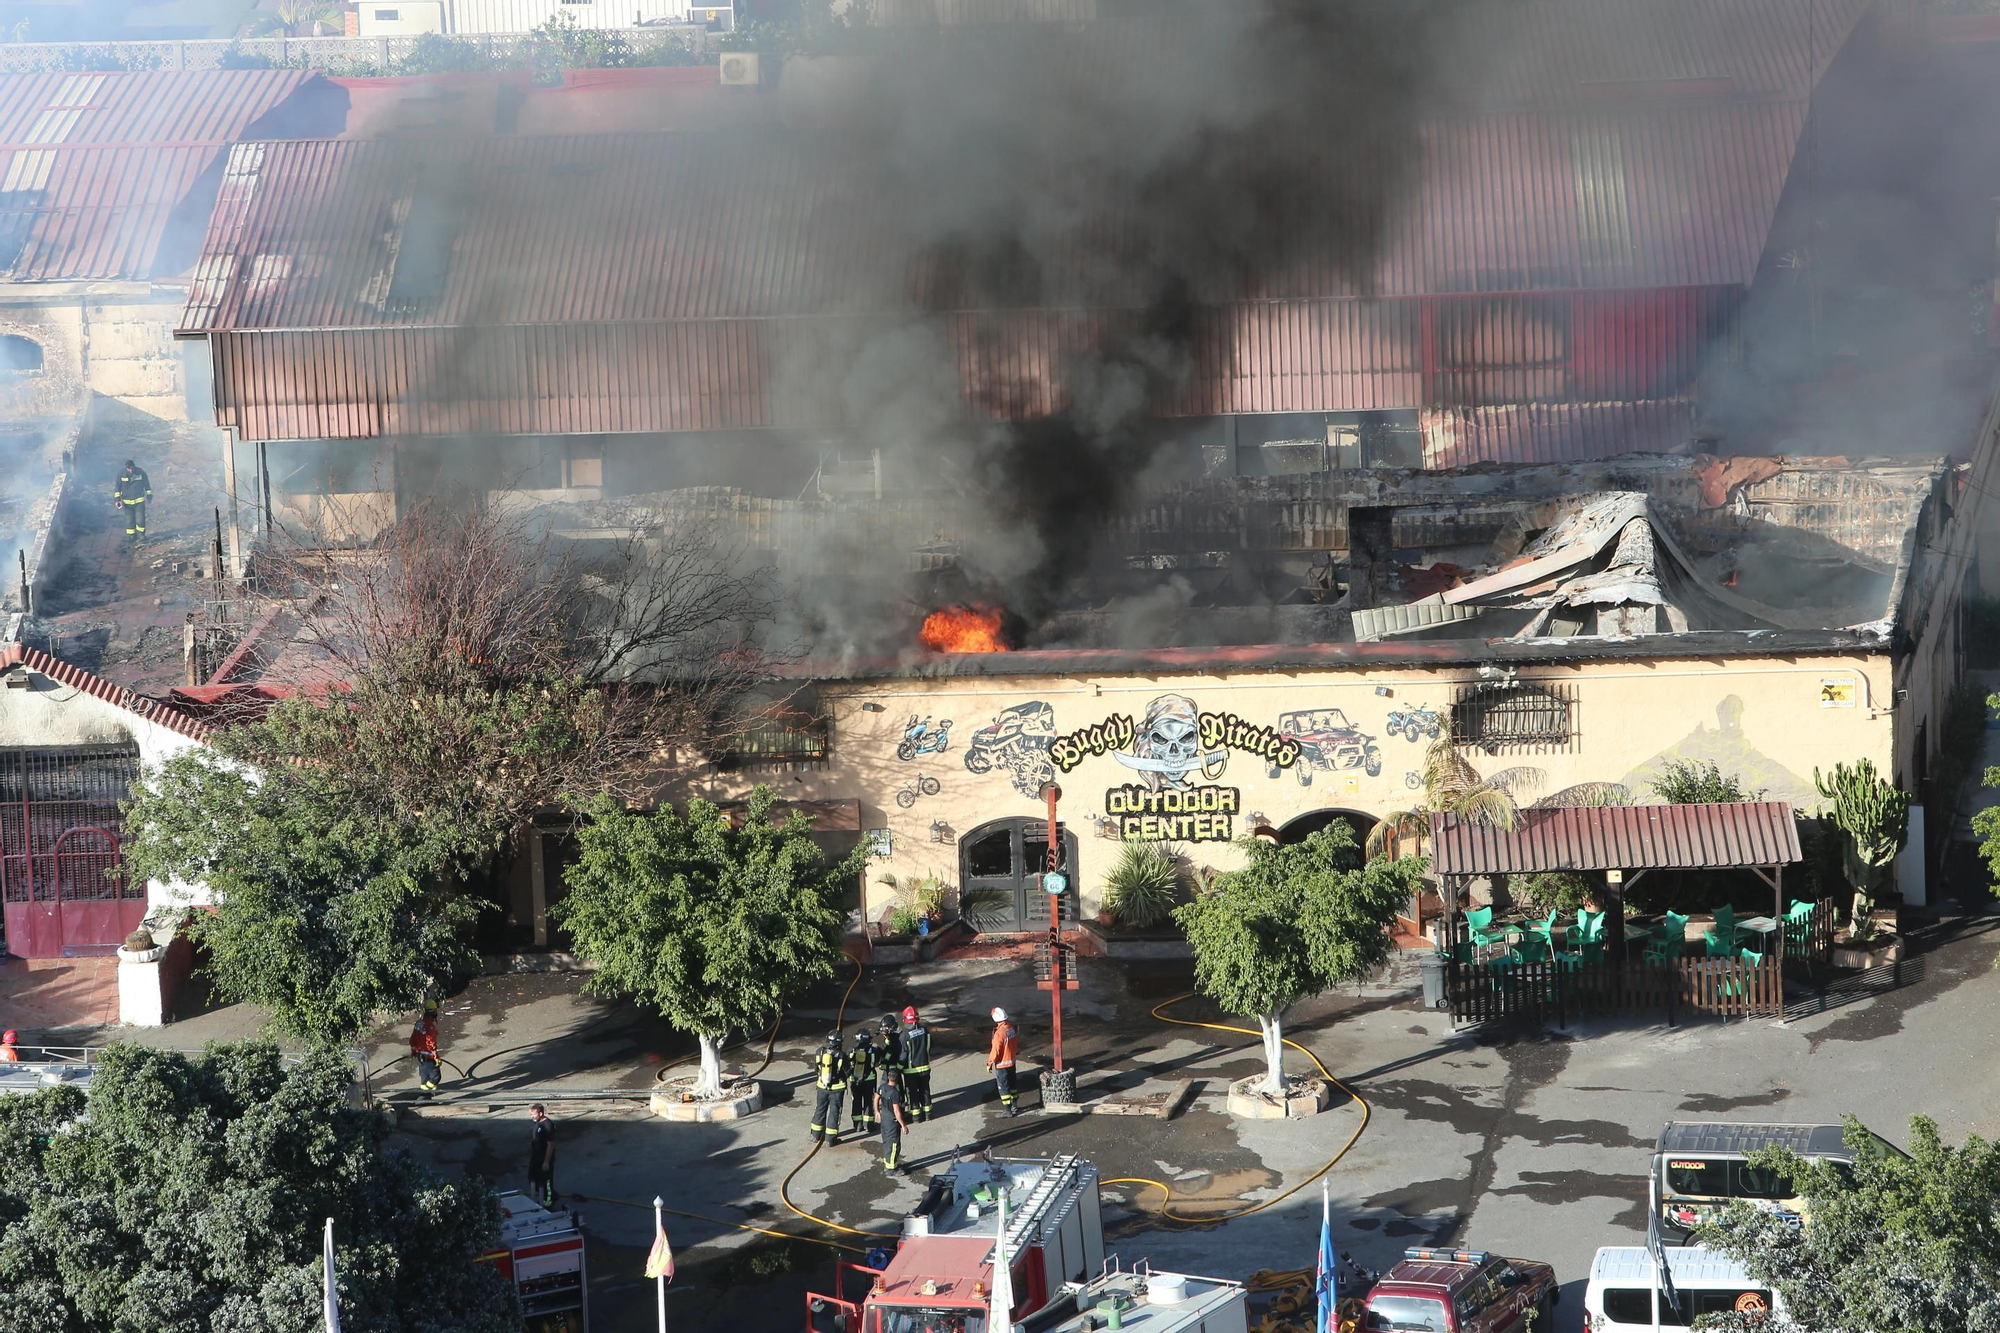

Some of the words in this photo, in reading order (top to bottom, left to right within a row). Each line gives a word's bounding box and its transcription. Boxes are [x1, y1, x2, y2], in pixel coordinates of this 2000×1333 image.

[1050, 714, 1135, 771] Buggy
[1199, 713, 1301, 767] Pirates
[1108, 788, 1237, 813] OUTDOOR
[1123, 816, 1230, 840] CENTER
[1670, 1160, 1706, 1170] OUTDOOR
